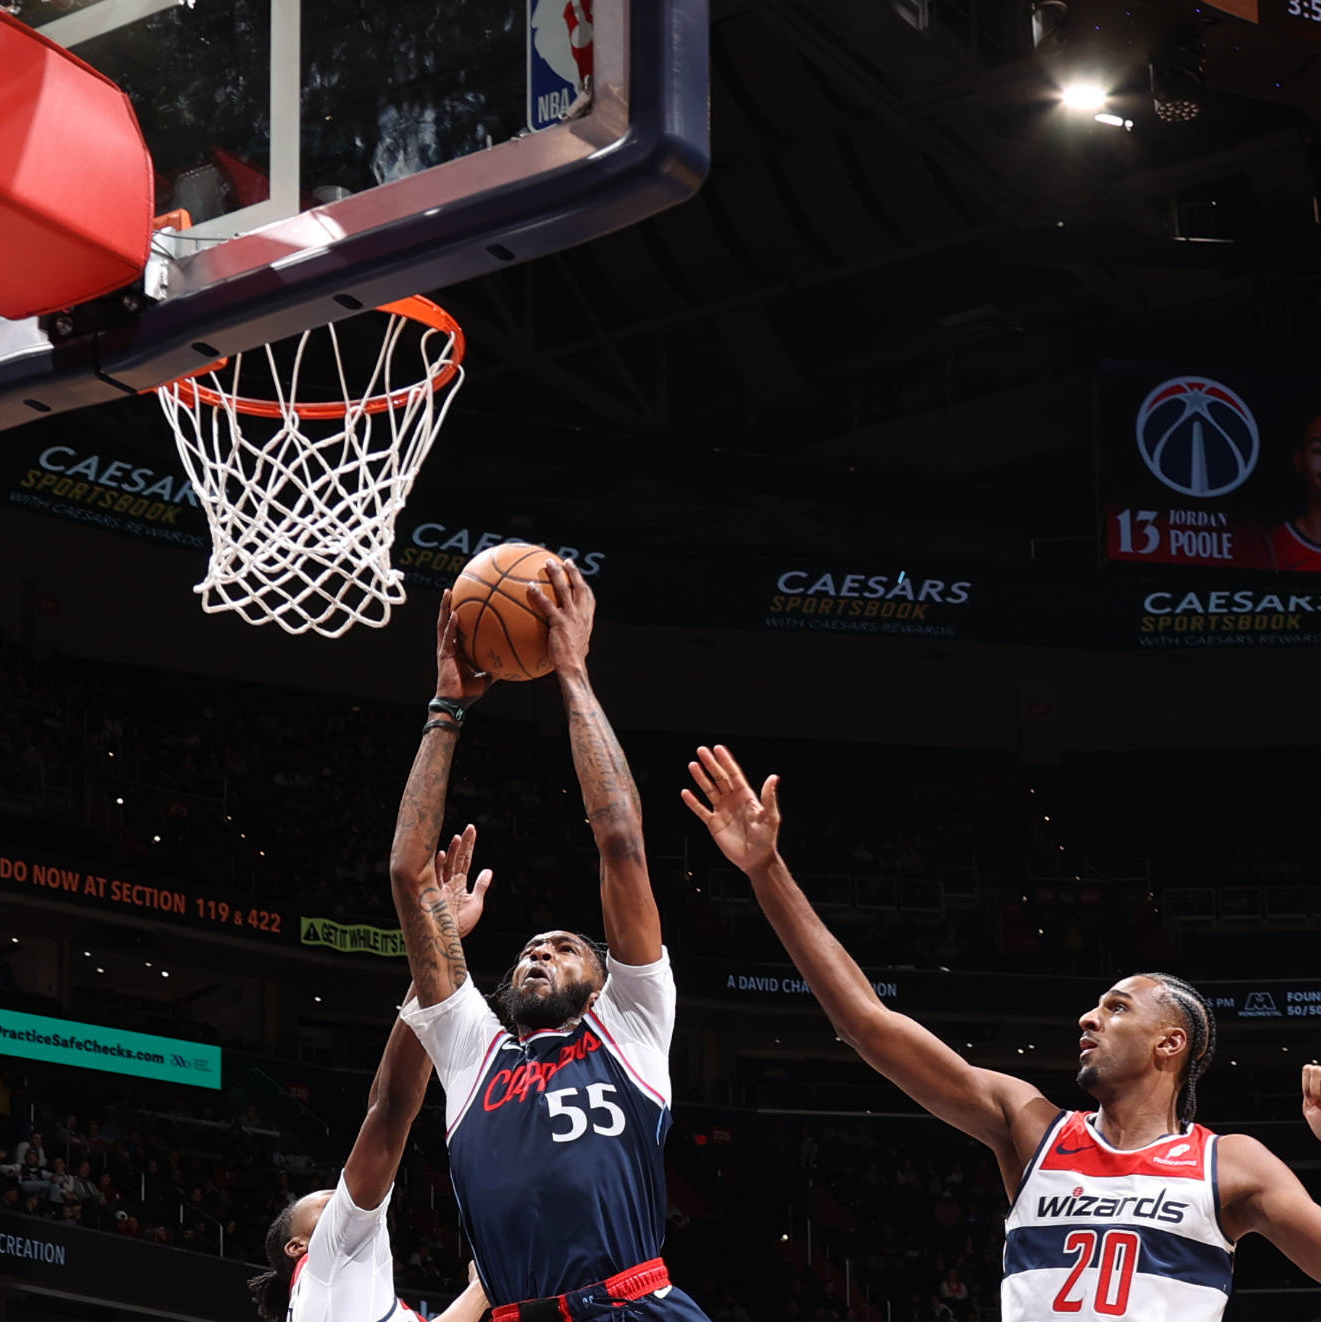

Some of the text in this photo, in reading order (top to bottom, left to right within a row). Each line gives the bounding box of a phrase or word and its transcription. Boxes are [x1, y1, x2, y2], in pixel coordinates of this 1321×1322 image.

[537, 87, 571, 123] NBA
[38, 445, 230, 508] CAESAR
[19, 468, 183, 526] SPORTSBOOK
[1115, 507, 1229, 556] 13 JORDAN
[1170, 530, 1233, 560] POOLE
[776, 569, 973, 604] CAESARS
[769, 595, 929, 621] SPORTSBOOK
[1141, 614, 1302, 632] SPORTSBOOK
[31, 863, 81, 893] NOW
[83, 874, 107, 900] AT
[110, 879, 186, 915] SECTION
[195, 897, 229, 924] 119
[233, 909, 244, 926] &
[247, 908, 283, 933] 422
[349, 928, 379, 952] WHILE
[727, 974, 813, 995] A DAVID CHA
[545, 1082, 626, 1143] 55
[1036, 1186, 1190, 1224] wizards
[1051, 1229, 1141, 1319] 20
